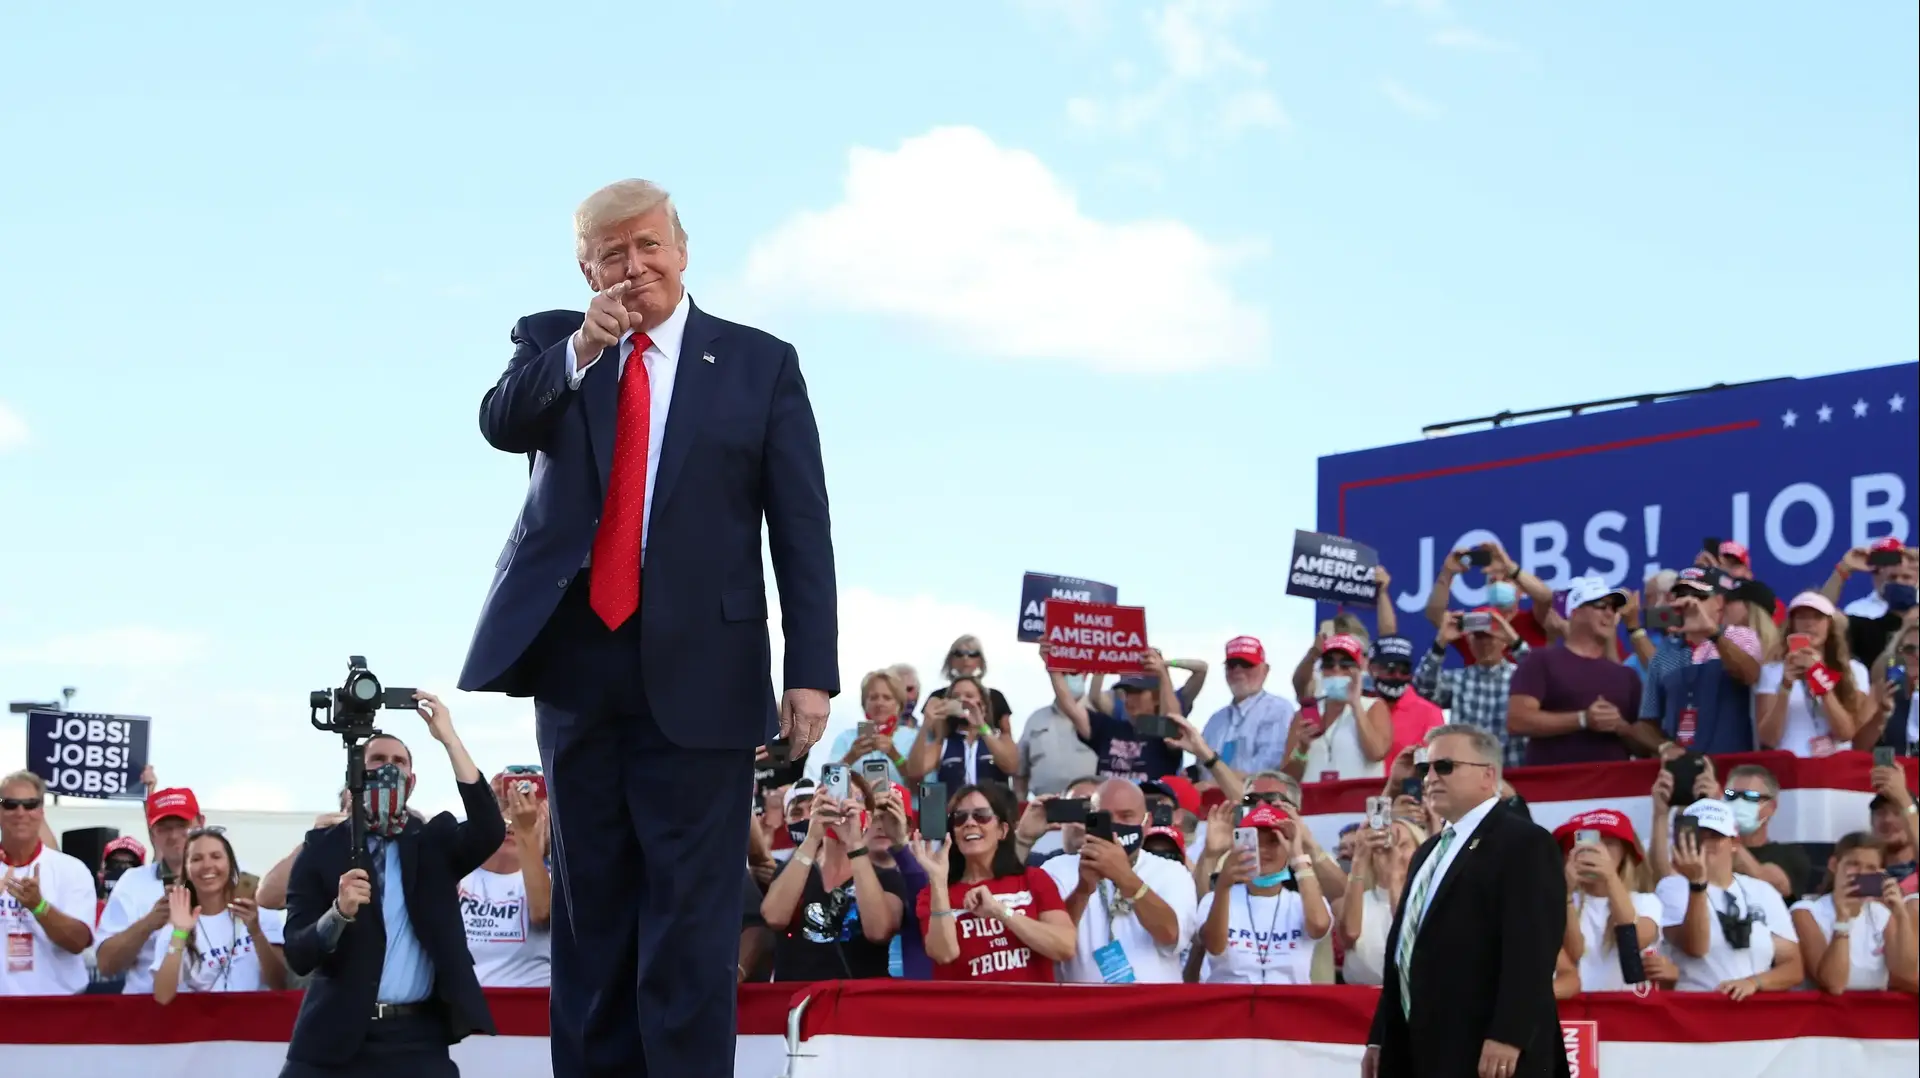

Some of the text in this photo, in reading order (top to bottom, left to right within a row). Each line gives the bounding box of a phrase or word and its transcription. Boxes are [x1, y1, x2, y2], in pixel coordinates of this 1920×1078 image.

[1320, 544, 1358, 562] MAKE
[1294, 554, 1376, 582] AMERICA
[1052, 587, 1092, 603] MAKE
[1291, 572, 1376, 598] GREAT AGAIN
[1074, 612, 1114, 627] MAKE
[1049, 625, 1143, 648] AMERICA
[1050, 645, 1095, 661] GREAT
[47, 718, 131, 744] JOBS!
[45, 742, 130, 769] JOBS!
[45, 767, 128, 793] JOBS!
[1228, 928, 1302, 942] TRUMP
[968, 947, 1031, 977] TRUMP
